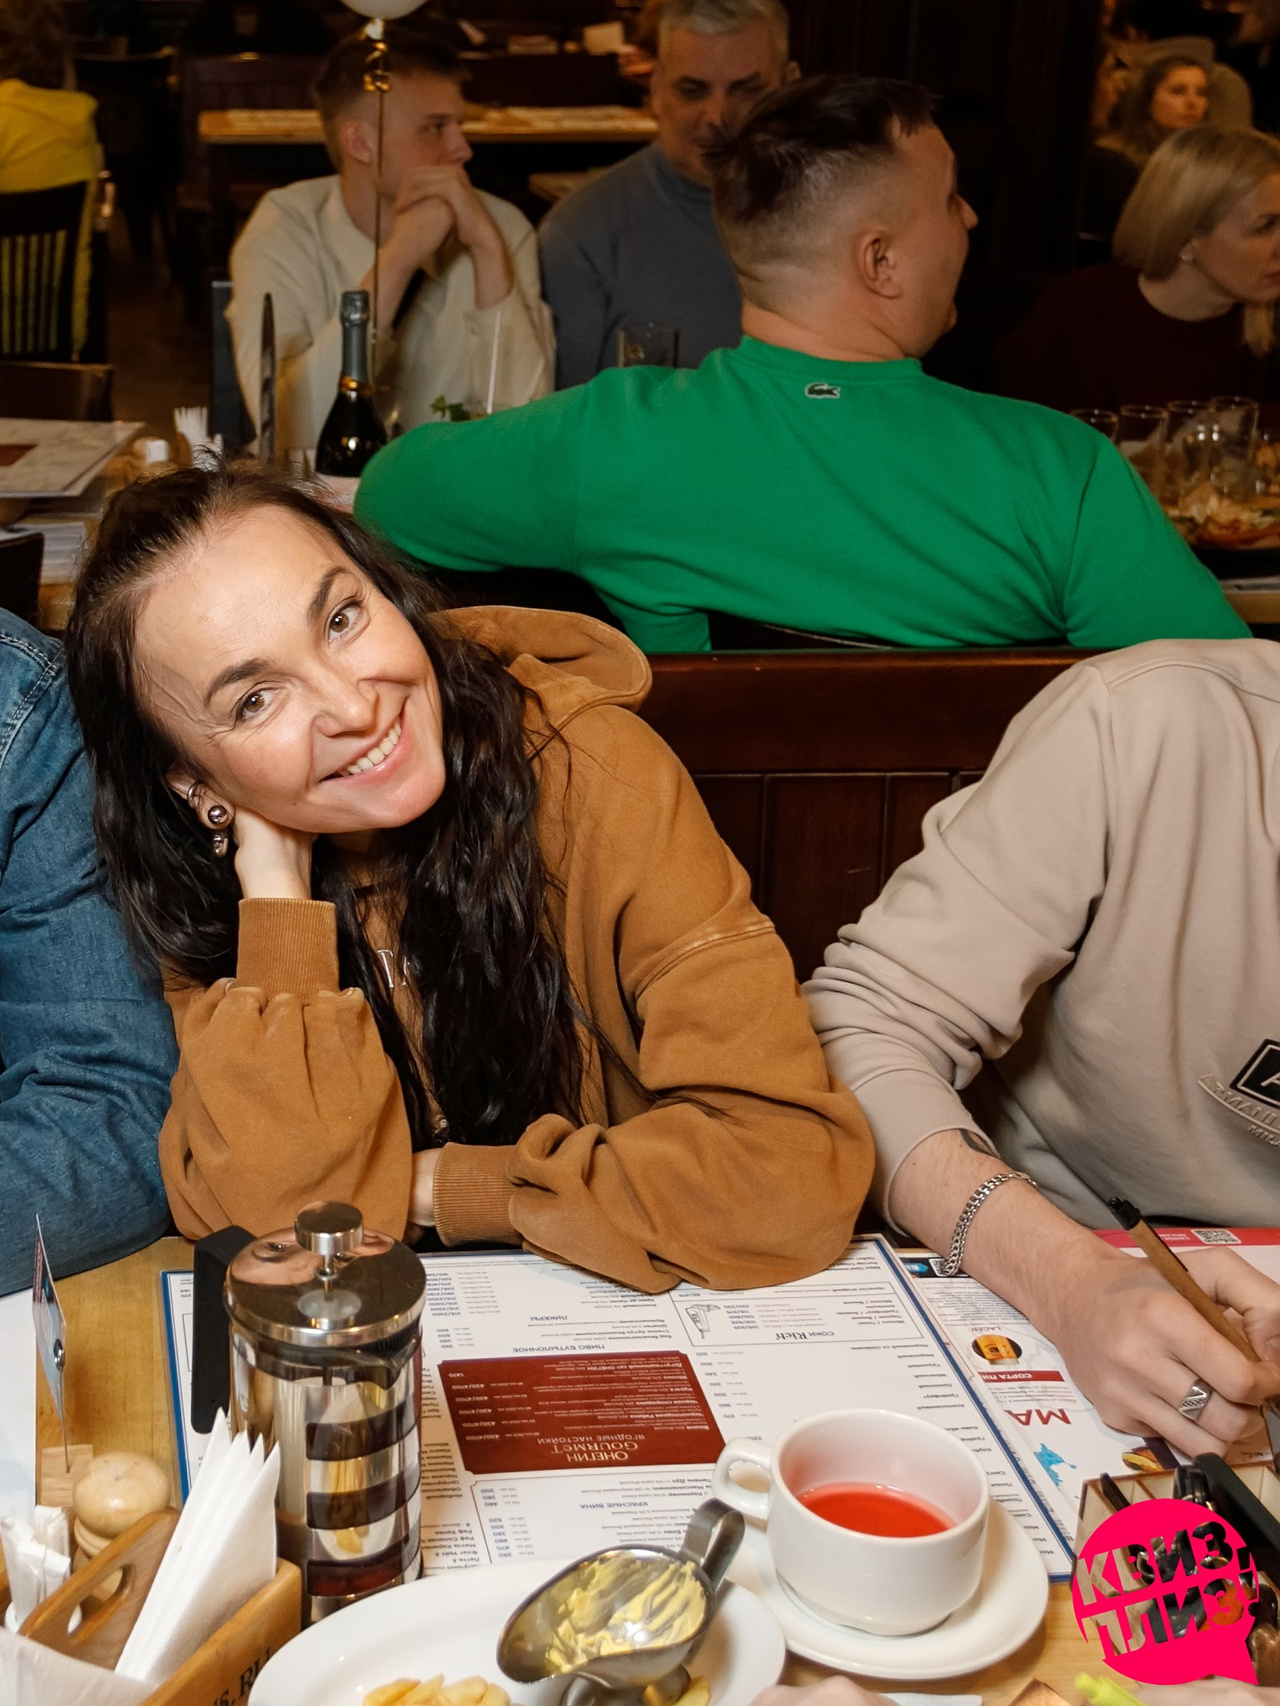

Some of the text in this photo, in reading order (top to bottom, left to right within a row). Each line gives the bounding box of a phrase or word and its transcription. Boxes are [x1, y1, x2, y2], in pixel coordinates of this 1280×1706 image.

[775, 1331, 808, 1341] Rich
[512, 1345, 576, 1353] БУТЫЛОЧНОЕ
[537, 1433, 645, 1445] ЯГОДНЫЕ НАСТОЙКИ
[566, 1451, 629, 1462] ОНЕГИН
